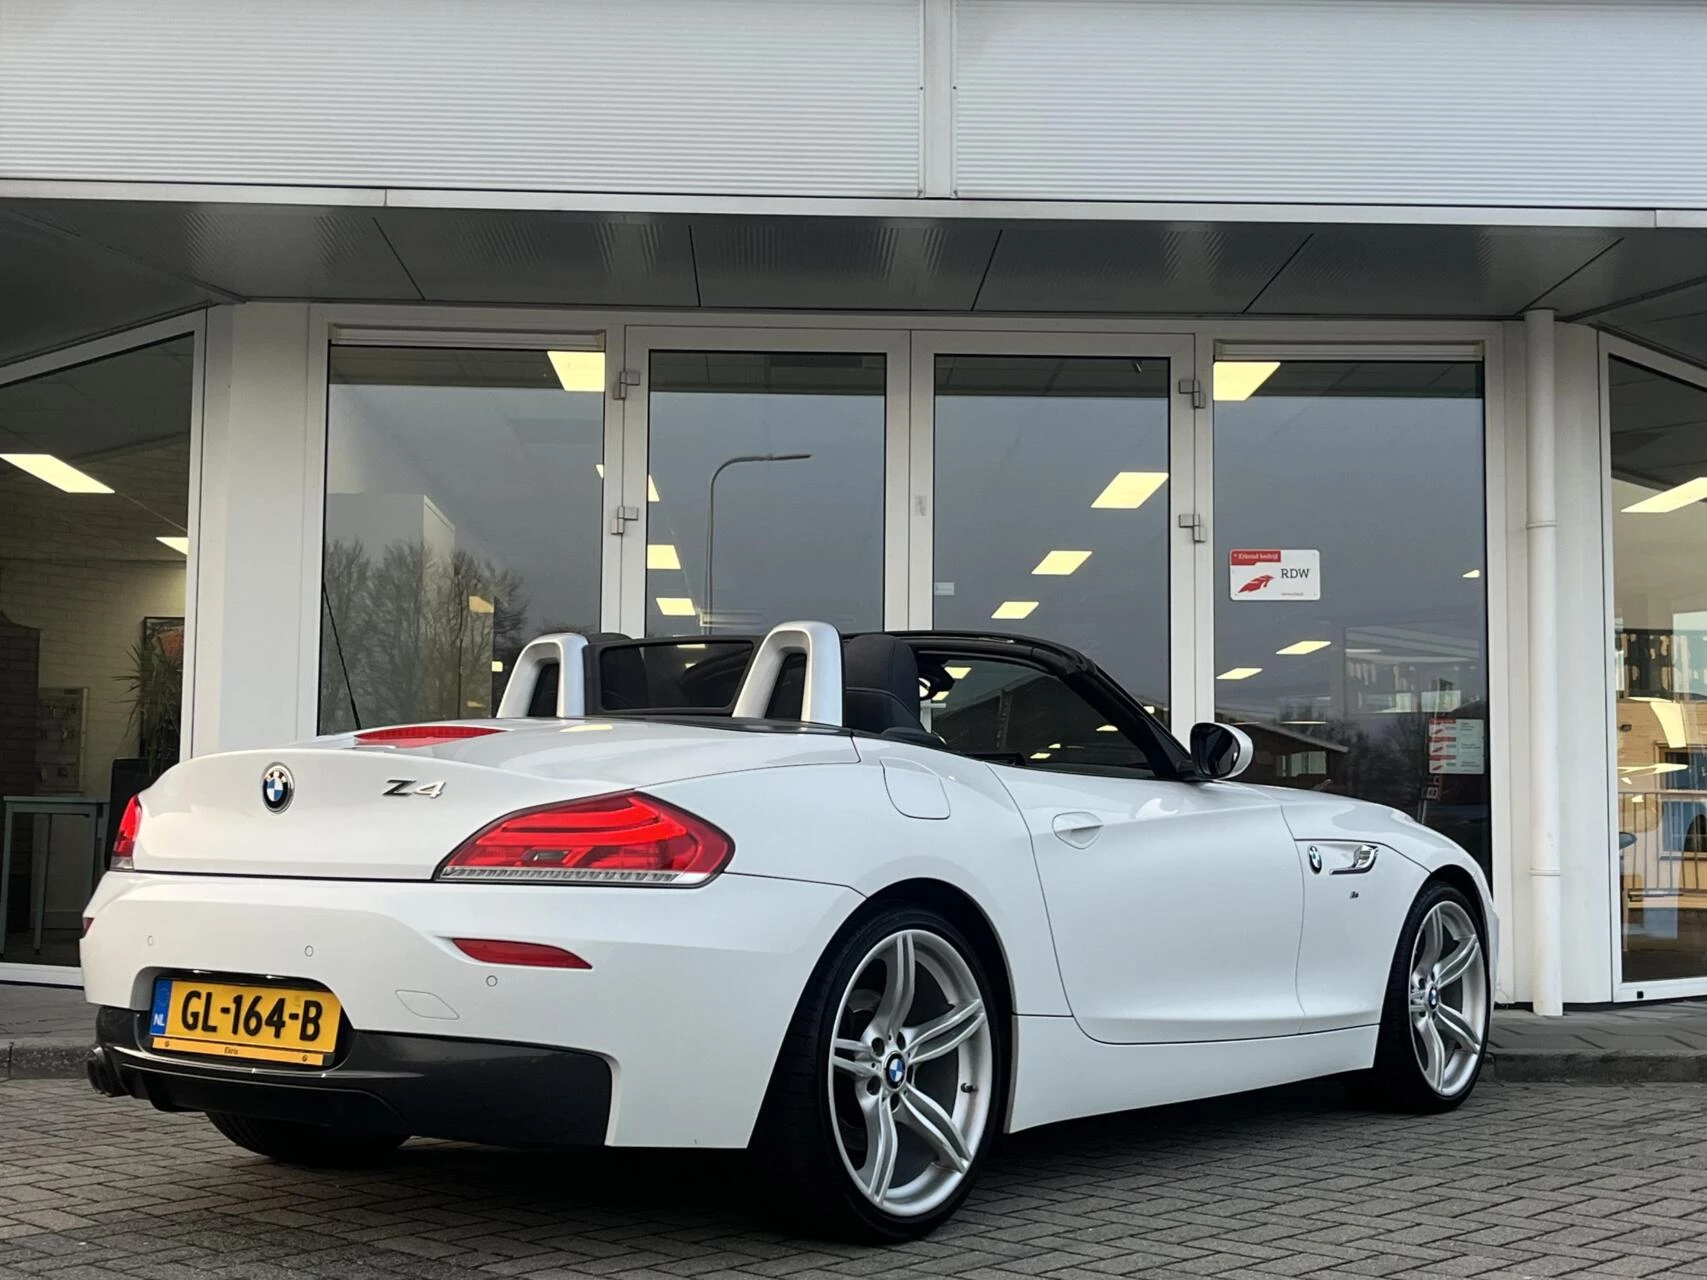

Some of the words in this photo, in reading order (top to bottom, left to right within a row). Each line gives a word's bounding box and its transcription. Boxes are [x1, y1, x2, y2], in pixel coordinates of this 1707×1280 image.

[1280, 568, 1310, 579] RDW
[382, 778, 447, 799] Z4
[153, 1014, 165, 1027] NL
[181, 990, 323, 1042] GL-164-B
